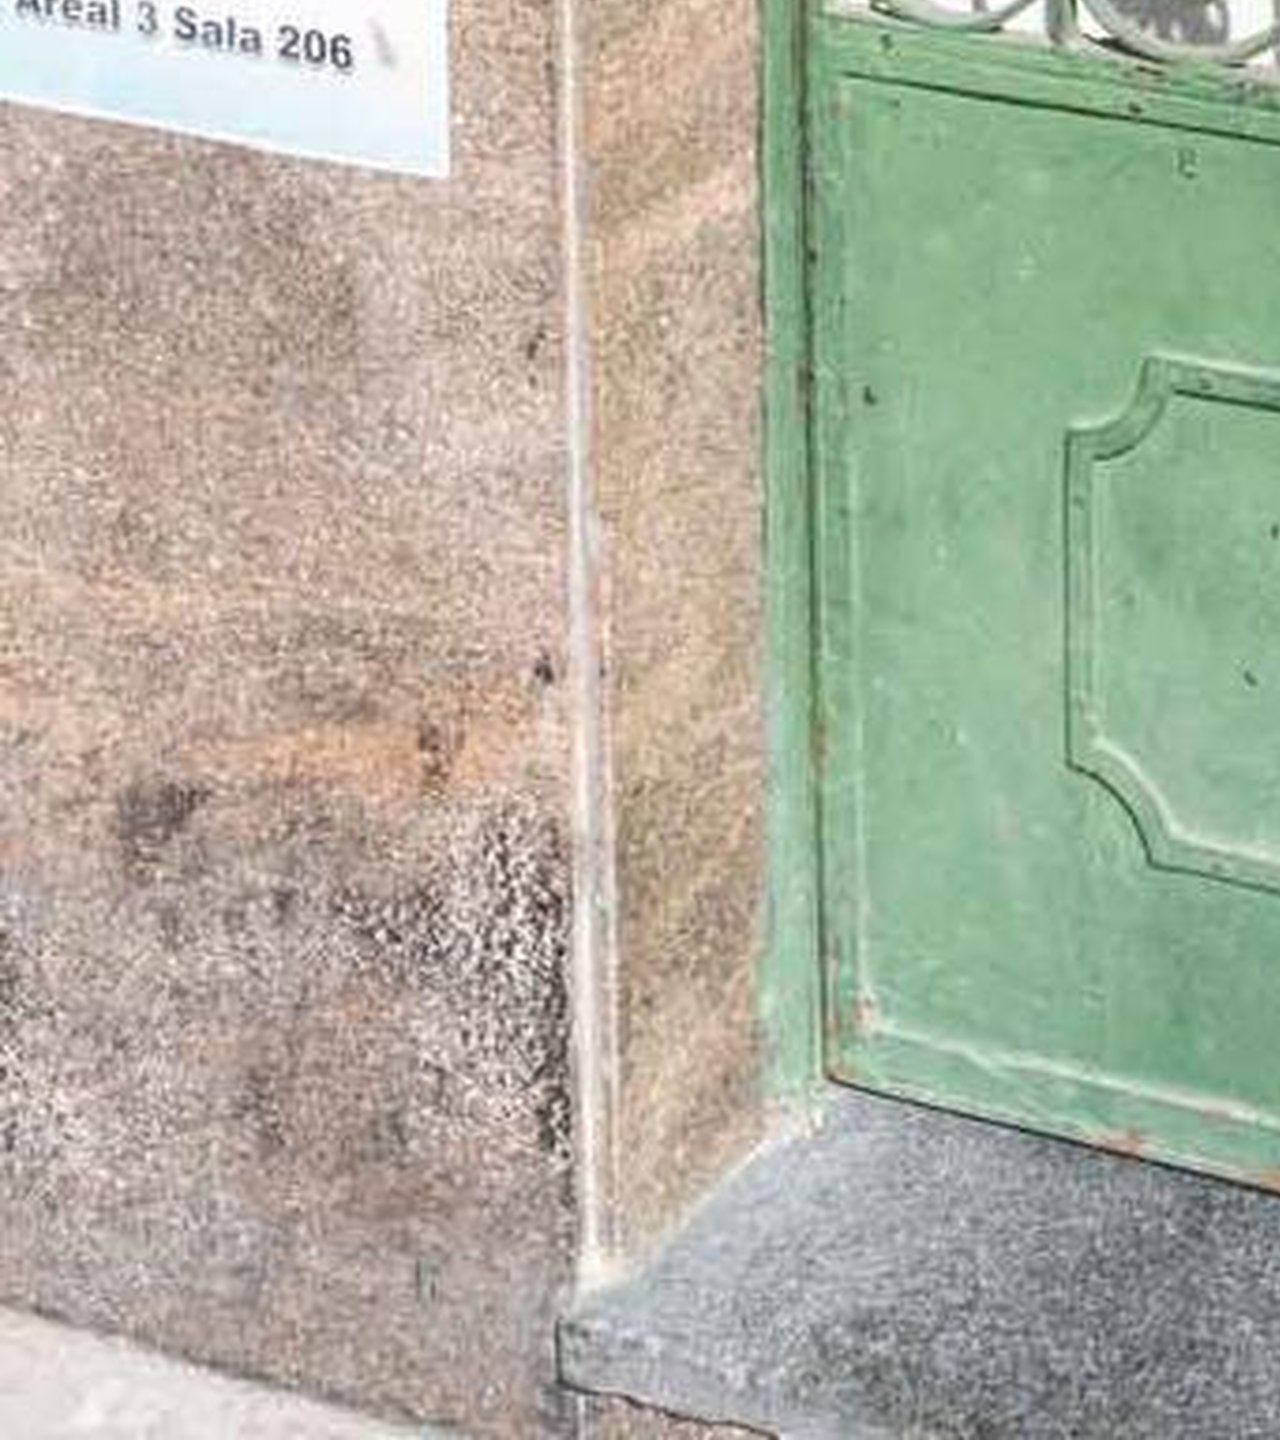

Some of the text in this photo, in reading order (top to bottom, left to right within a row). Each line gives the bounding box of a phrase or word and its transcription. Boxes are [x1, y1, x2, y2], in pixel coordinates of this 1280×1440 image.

[137, 0, 160, 37] 3
[173, 5, 264, 56] Sala
[278, 24, 355, 71] 206
